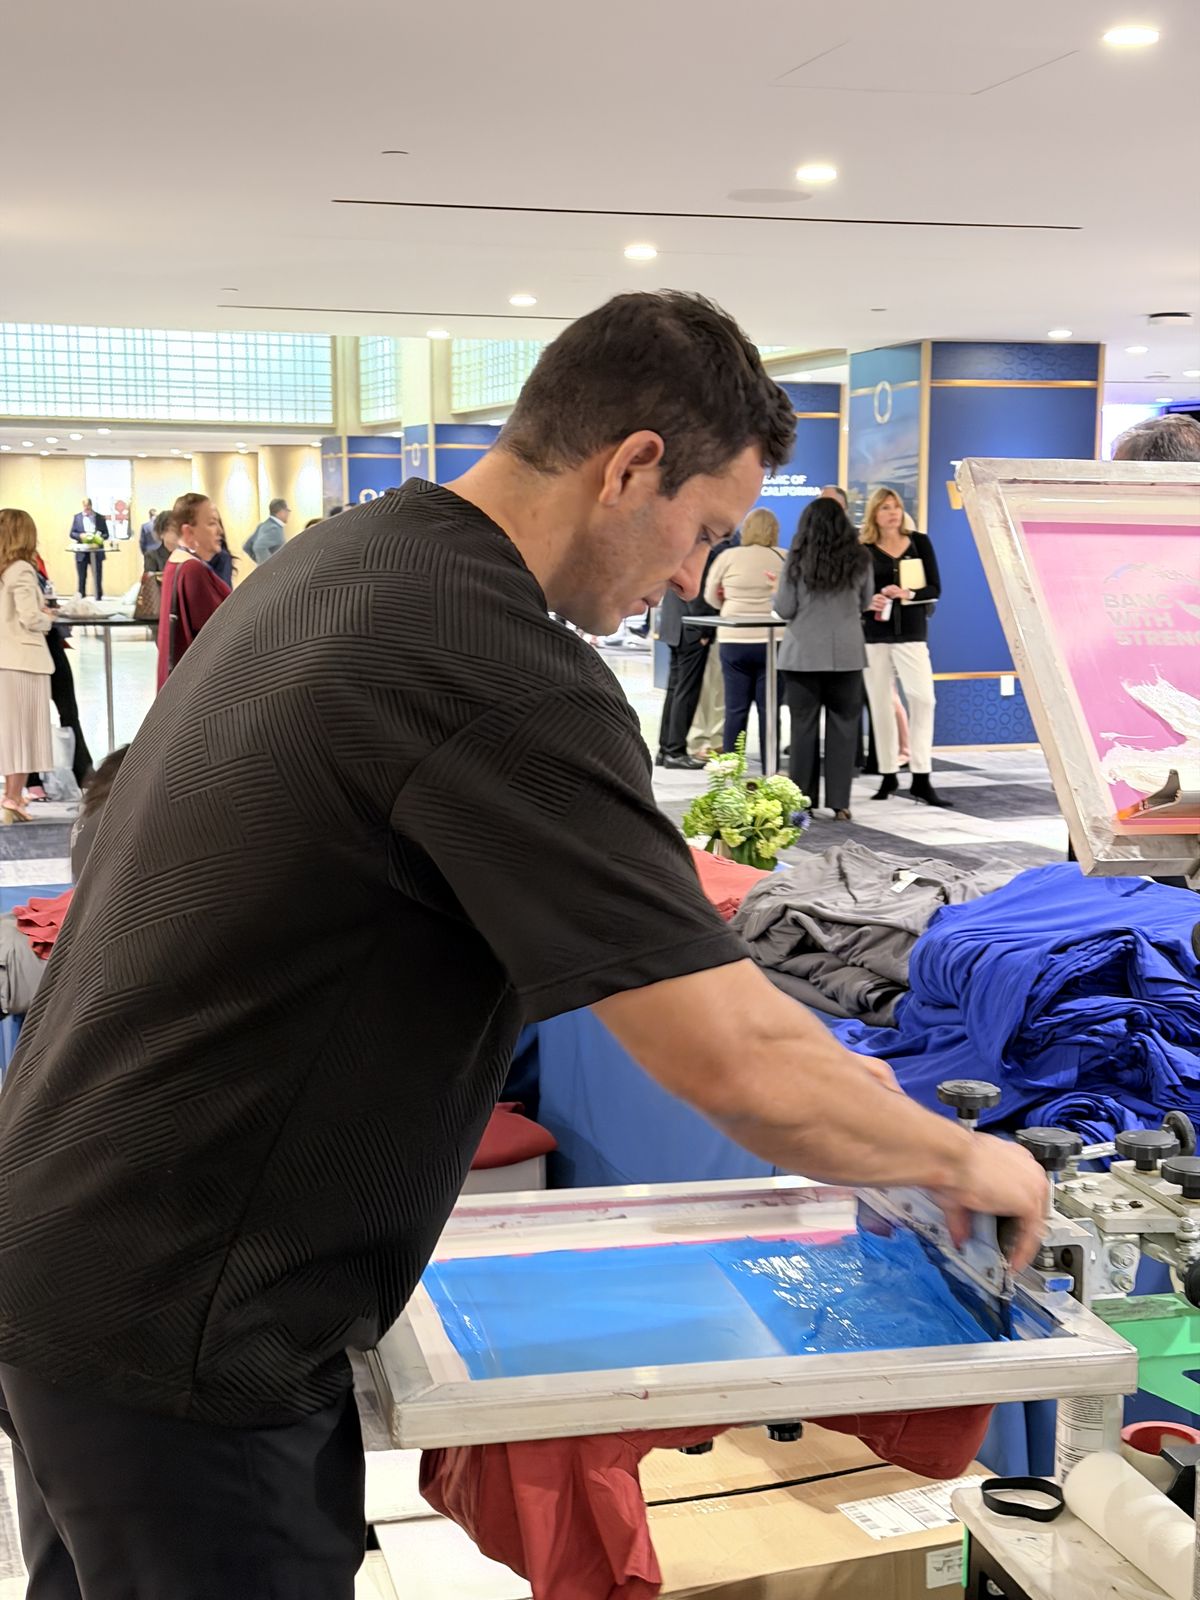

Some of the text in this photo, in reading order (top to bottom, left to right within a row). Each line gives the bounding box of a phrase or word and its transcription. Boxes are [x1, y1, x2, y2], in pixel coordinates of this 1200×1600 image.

[790, 474, 808, 485] OF
[1103, 593, 1173, 608] BANC
[1106, 611, 1173, 628] WITH
